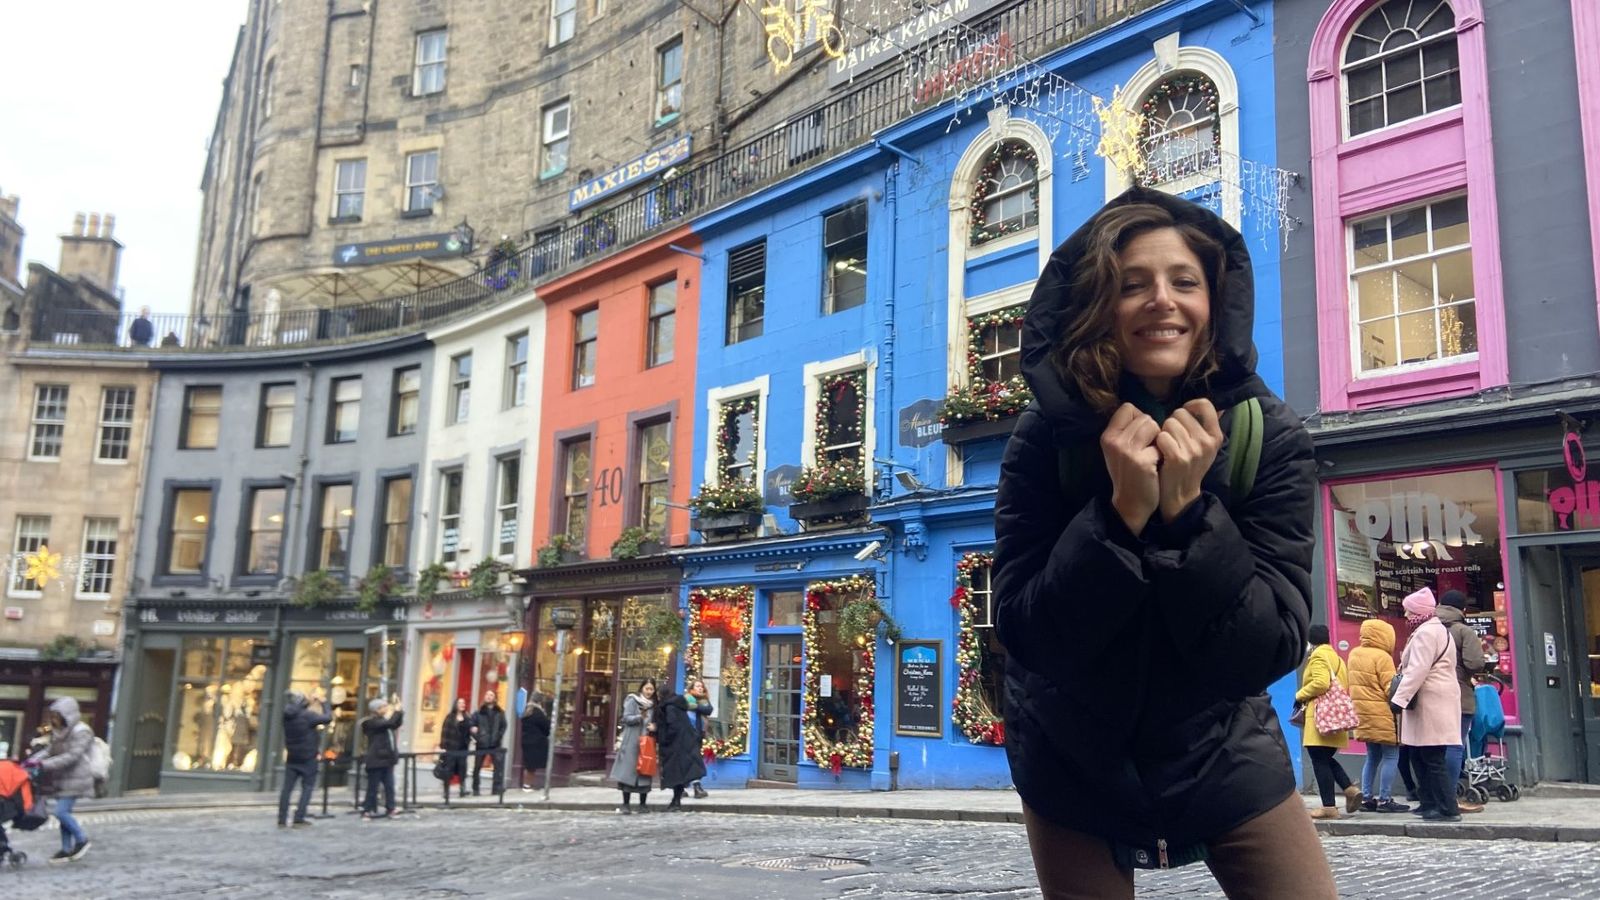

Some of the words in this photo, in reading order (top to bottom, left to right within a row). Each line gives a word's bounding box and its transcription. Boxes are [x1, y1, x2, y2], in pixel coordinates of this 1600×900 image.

[902, 0, 969, 40] KANAM
[572, 151, 660, 205] MAXIES
[594, 466, 623, 507] 40
[1355, 491, 1483, 560] oink
[1395, 566, 1424, 575] scottish
[1425, 565, 1440, 575] hog
[1441, 565, 1462, 573] roast
[1463, 564, 1481, 572] rolls
